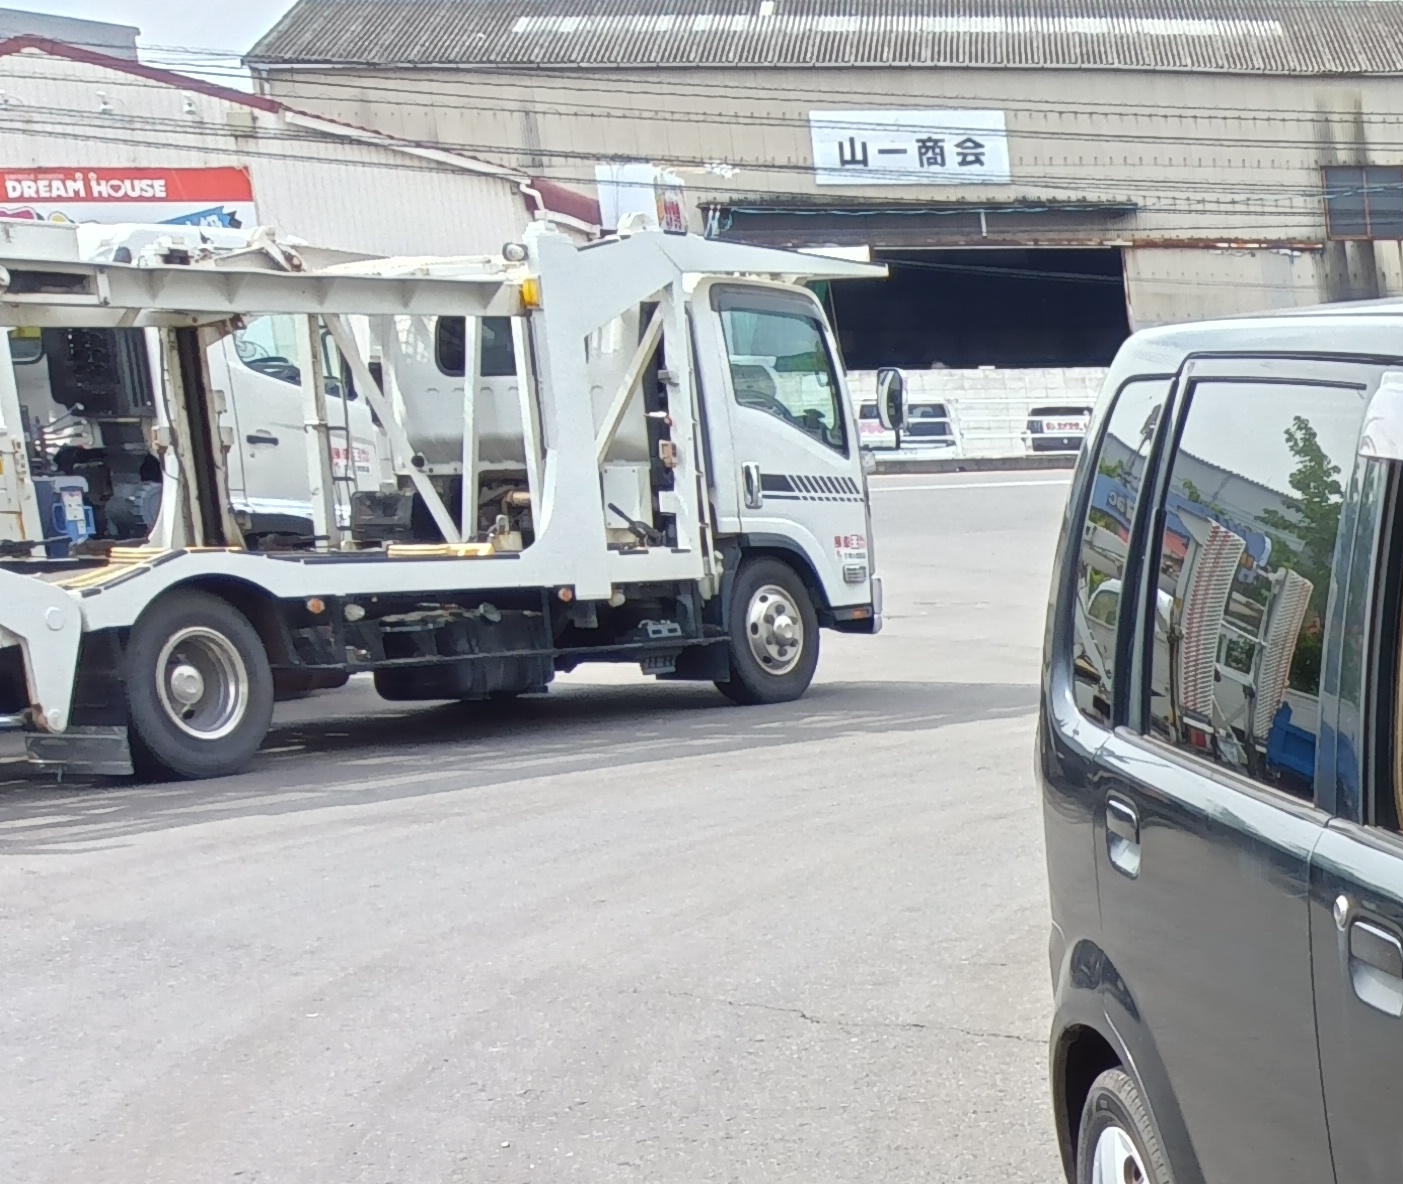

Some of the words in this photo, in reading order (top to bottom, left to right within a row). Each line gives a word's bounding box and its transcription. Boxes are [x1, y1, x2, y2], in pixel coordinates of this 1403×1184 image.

[838, 136, 986, 168] 山一商会
[5, 173, 86, 198] DREAM
[88, 172, 167, 198] HOUSE
